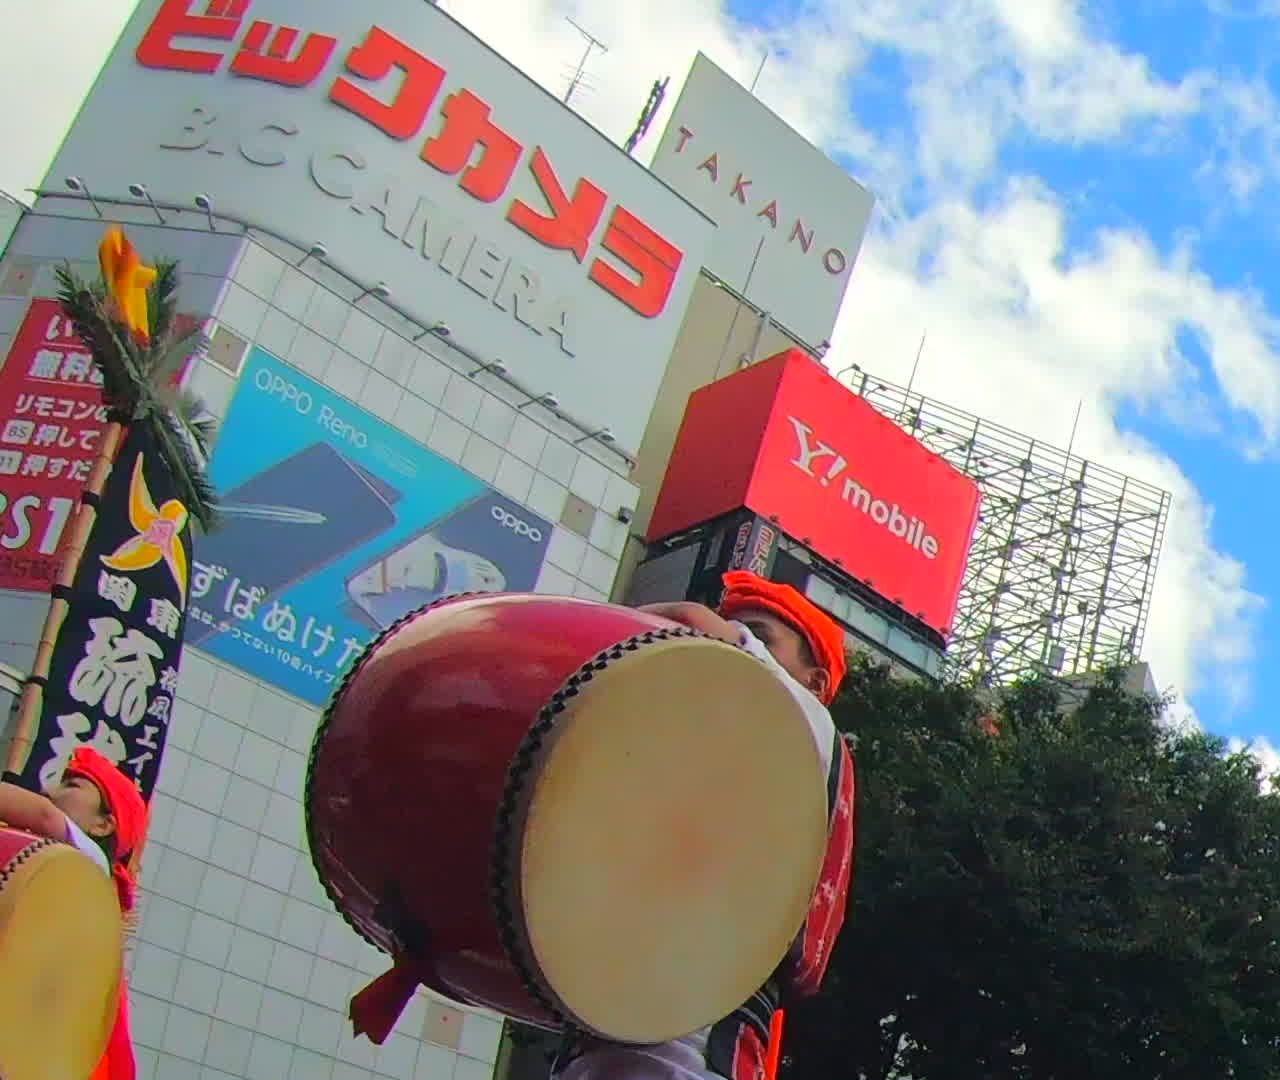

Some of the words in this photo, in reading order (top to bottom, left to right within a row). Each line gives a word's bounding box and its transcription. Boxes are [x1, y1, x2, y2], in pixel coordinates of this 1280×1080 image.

[136, 0, 685, 319] ビックカメラ
[675, 125, 846, 274] TAKANO
[307, 148, 577, 358] CAMERA
[255, 367, 314, 417] OPPO
[316, 404, 369, 449] Reno
[490, 505, 543, 543] oppo
[841, 475, 940, 561] mobile
